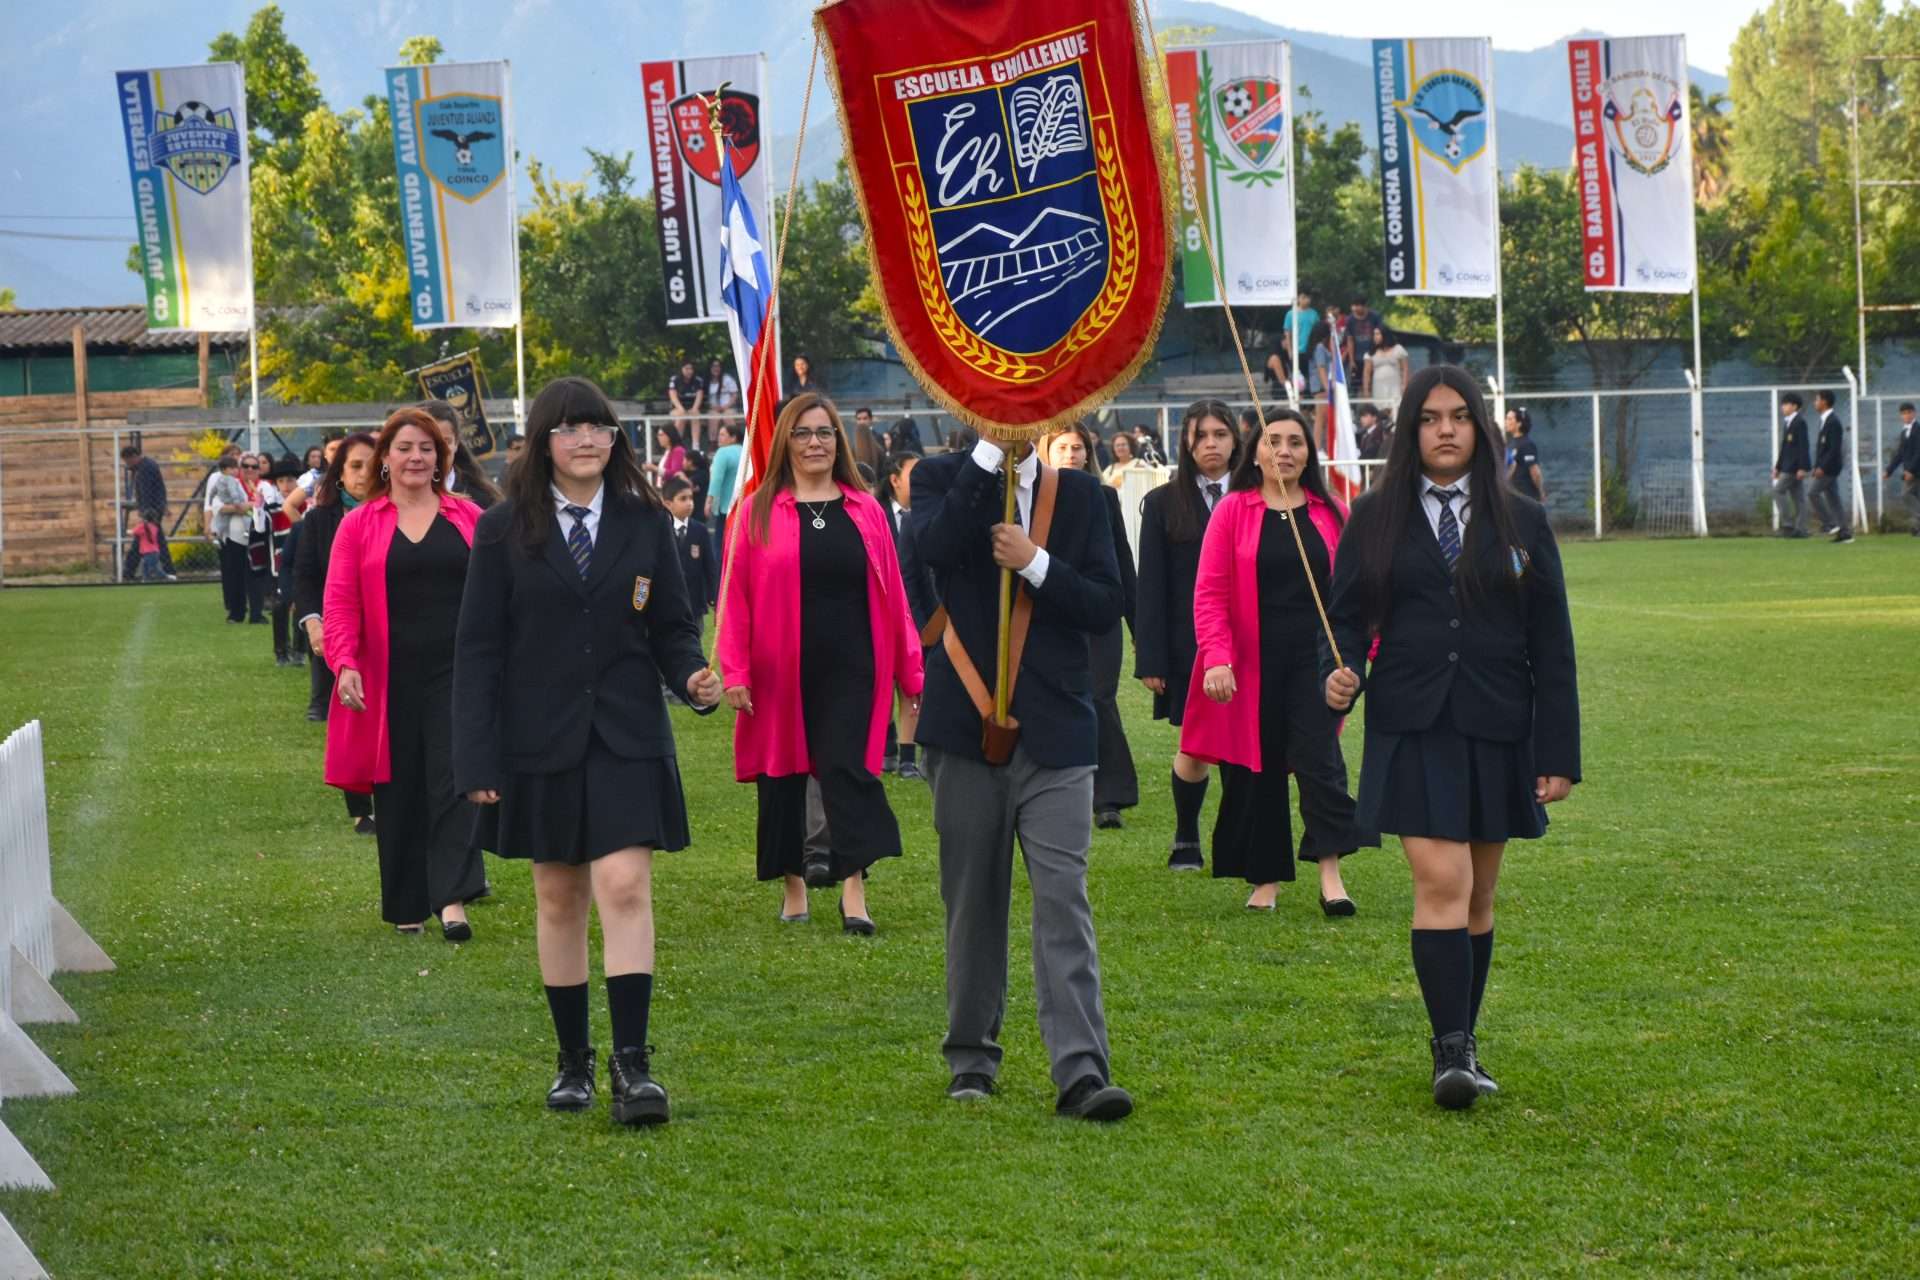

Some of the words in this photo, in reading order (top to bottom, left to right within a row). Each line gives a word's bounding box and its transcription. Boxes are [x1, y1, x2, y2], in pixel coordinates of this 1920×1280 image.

[894, 65, 985, 99] ESCUELA
[991, 32, 1089, 82] CHILLEHUE
[1575, 49, 1593, 101] CHILE
[123, 78, 150, 171] ESTRELLA
[393, 73, 417, 165] ALIANZA
[1378, 47, 1398, 163] GARMENDIA
[1580, 109, 1596, 136] DE
[166, 130, 228, 143] JUVENTUD
[649, 80, 676, 211] VALENZUELA
[447, 175, 488, 185] COINCO
[1582, 142, 1603, 238] BANDERA
[137, 178, 164, 280] JUVENTUD
[404, 172, 429, 278] JUVENTUD
[1386, 168, 1404, 245] CONCHA
[663, 216, 682, 262] LUIS
[1186, 217, 1201, 251] CD.
[669, 268, 686, 304] CD.
[1390, 251, 1404, 283] CD.
[1589, 244, 1605, 279] CD.
[154, 288, 169, 322] CD.
[417, 284, 432, 320] CD.
